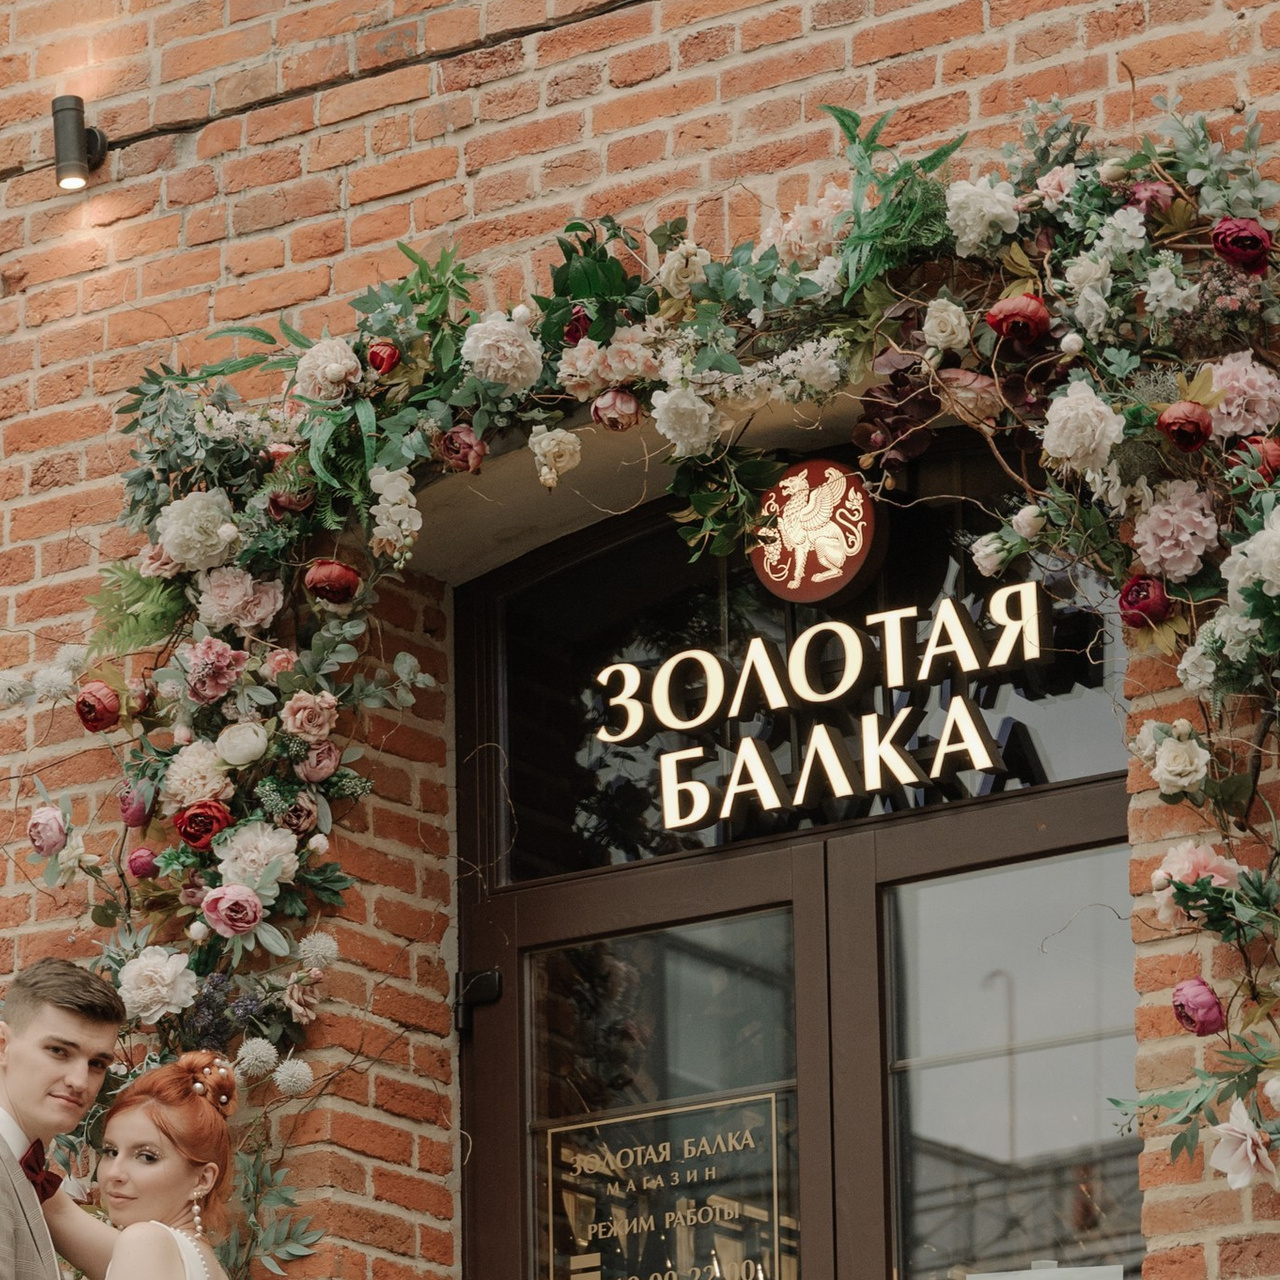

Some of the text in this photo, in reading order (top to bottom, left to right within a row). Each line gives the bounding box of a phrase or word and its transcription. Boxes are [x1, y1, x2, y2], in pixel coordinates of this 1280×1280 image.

[595, 581, 1041, 743] ЗОЛОТАЯ
[659, 695, 995, 829] БАЛКА
[570, 1129, 756, 1177] ЗОЛОТАЯ БАЛКА
[606, 1166, 718, 1196] МАГАЗИН
[587, 1202, 740, 1241] РЕЖИМ РАБОТЫ
